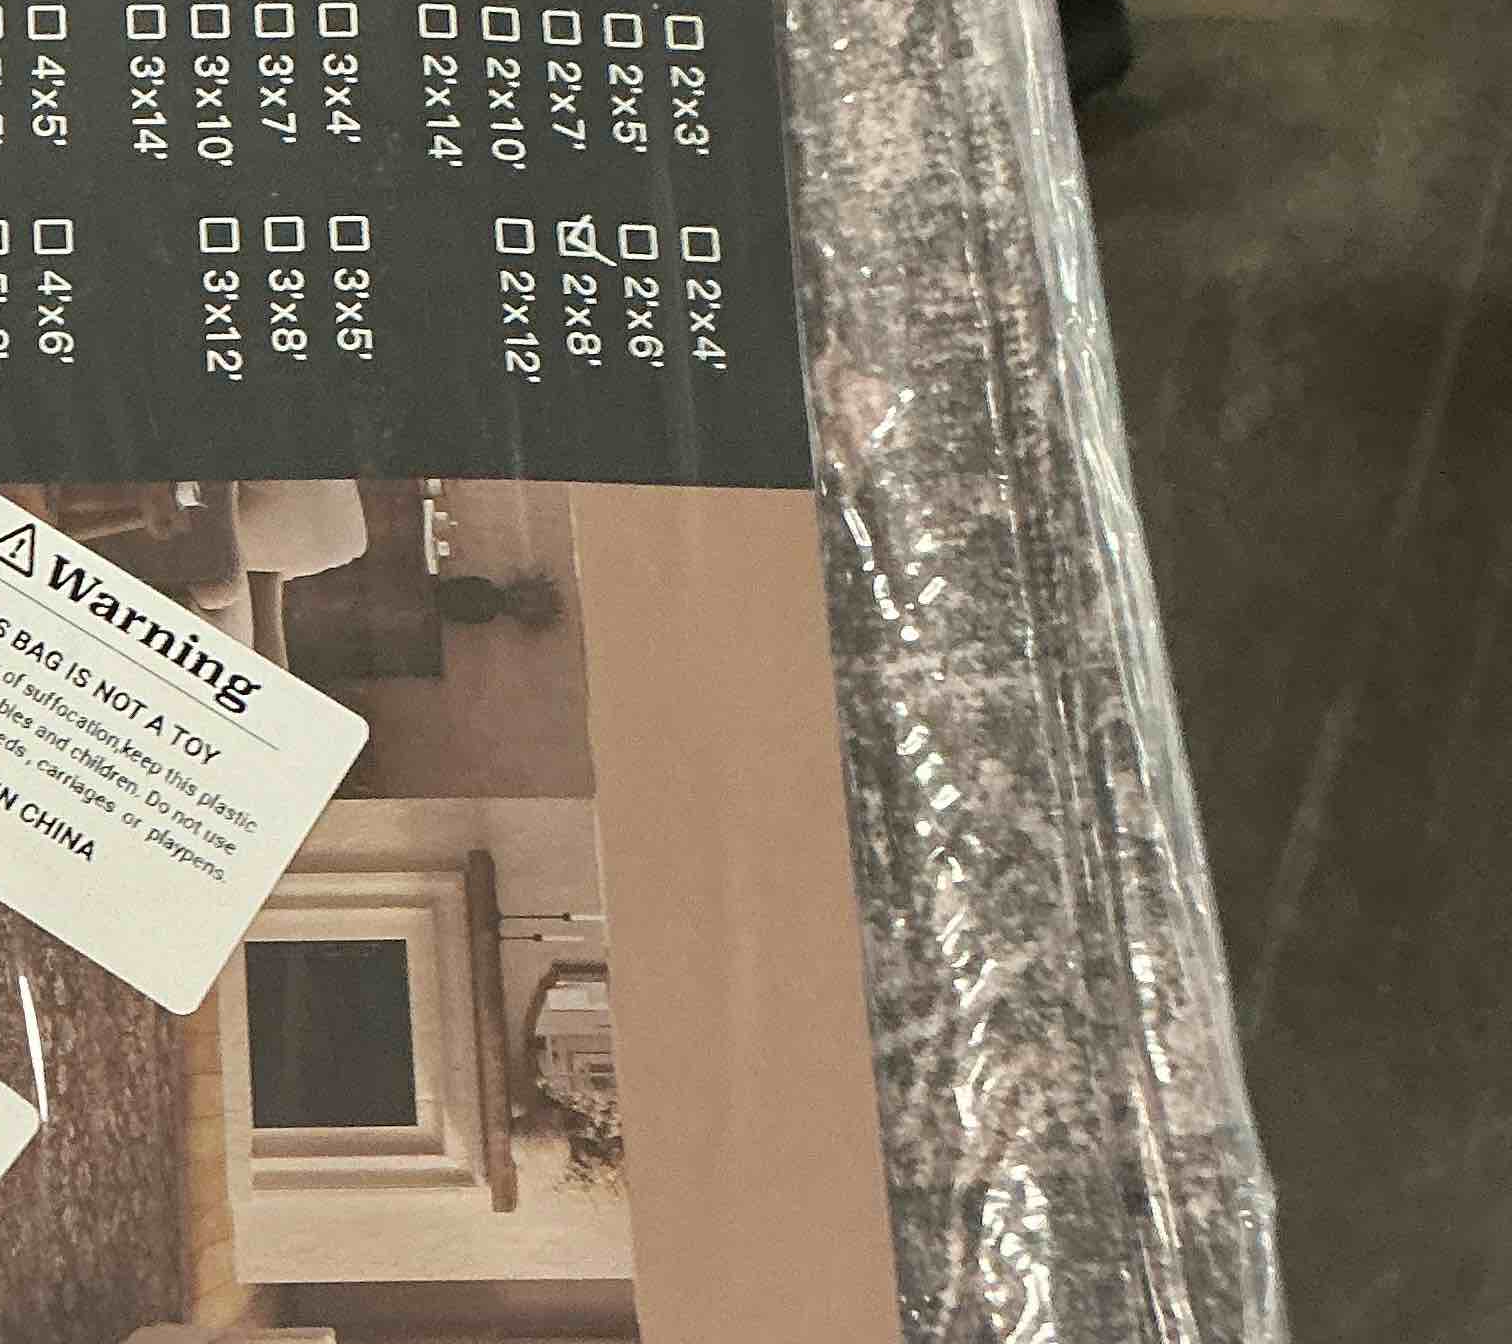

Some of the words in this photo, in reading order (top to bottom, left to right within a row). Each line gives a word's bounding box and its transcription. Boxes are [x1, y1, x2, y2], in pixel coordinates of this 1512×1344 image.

[31, 56, 68, 145] 4'x5'
[130, 56, 168, 159] 3'x14'
[194, 56, 233, 167] 3'x10'
[258, 55, 296, 143] 3'x7'
[323, 54, 361, 142] 3'x4'
[423, 55, 463, 166] 2'x14'
[487, 57, 526, 169] 2'x10'
[548, 61, 586, 149] 2'x7'
[608, 64, 647, 152] 2'x5'
[670, 66, 709, 154] 2'x3'
[38, 271, 74, 362] 4'x6'
[203, 270, 243, 380] 3'x12'
[268, 269, 307, 360] 3'x8'
[334, 268, 373, 359] 3'x5'
[500, 271, 541, 382] 2'x12'
[563, 274, 602, 365] 2'x8'
[624, 277, 664, 367] 2'x6'
[687, 279, 727, 369] 2'x4'
[47, 553, 264, 715] Warning
[9, 628, 65, 673] BAG
[63, 661, 95, 689] IS
[90, 678, 149, 721] NOT
[142, 714, 166, 738] A
[169, 723, 223, 766] TOY
[0, 671, 29, 690] of
[164, 767, 199, 798] this
[195, 792, 258, 834] plastic
[33, 725, 73, 752] and
[143, 789, 172, 815] Do
[170, 809, 204, 836] not
[201, 829, 238, 856] use
[18, 802, 97, 863] CHINA
[36, 759, 117, 817] carriages
[120, 808, 145, 829] or
[143, 824, 230, 885] playpens.
